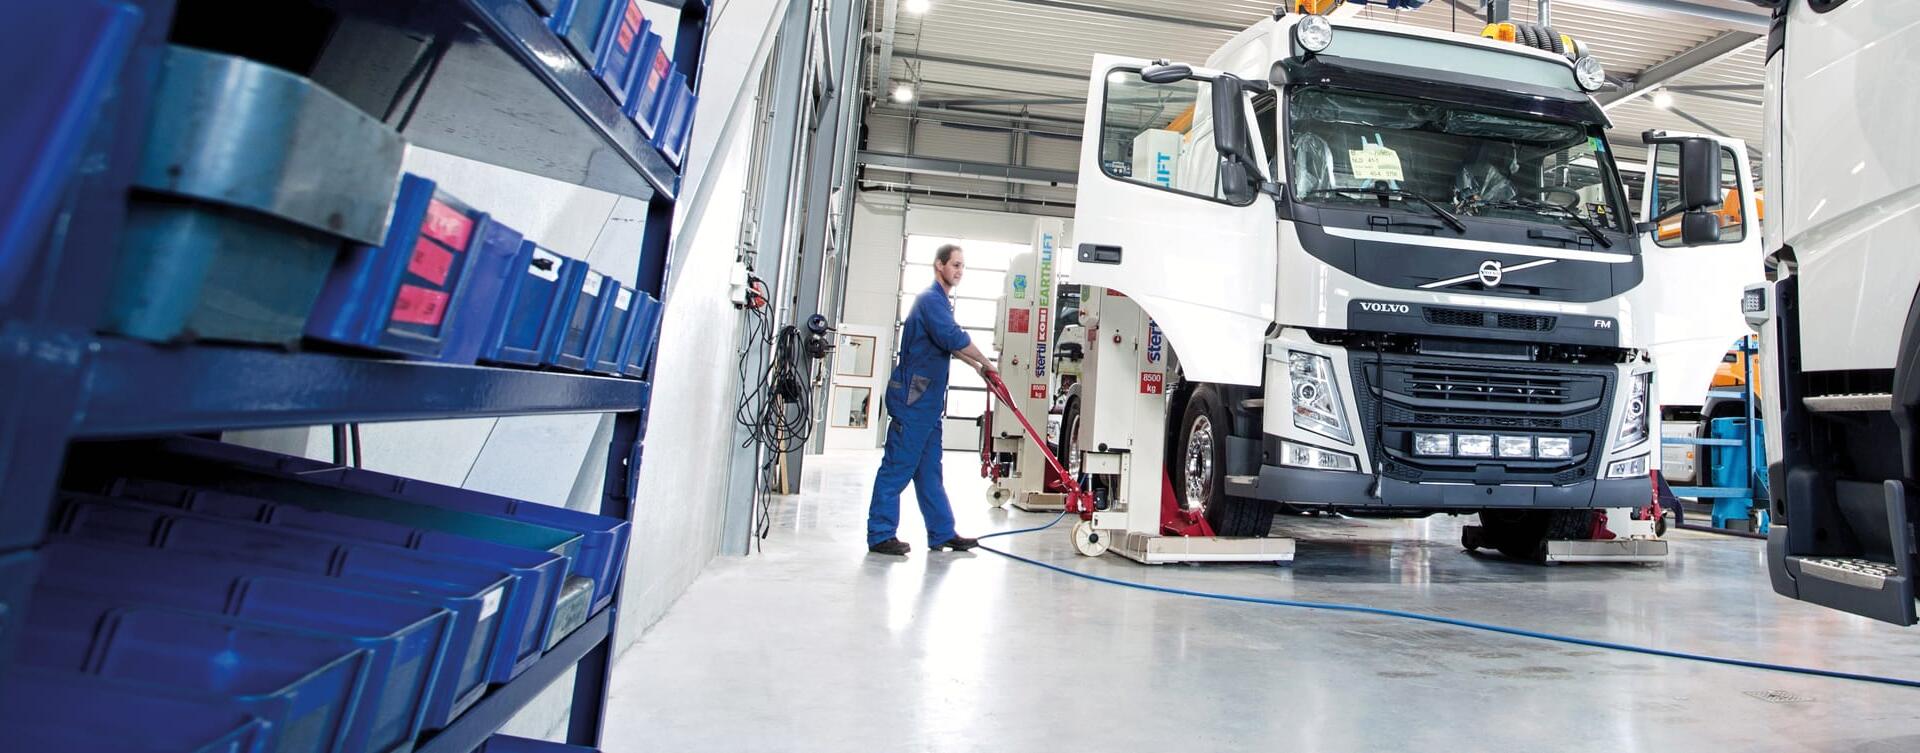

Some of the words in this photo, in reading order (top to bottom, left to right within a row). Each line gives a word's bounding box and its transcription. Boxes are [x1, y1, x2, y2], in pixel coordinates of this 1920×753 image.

[1040, 233, 1053, 306] EARTHLIFT
[1359, 302, 1410, 314] VOLVO
[1593, 319, 1611, 329] FM
[1147, 317, 1162, 362] stert
[1143, 373, 1161, 382] 8500
[1146, 383, 1157, 394] kg
